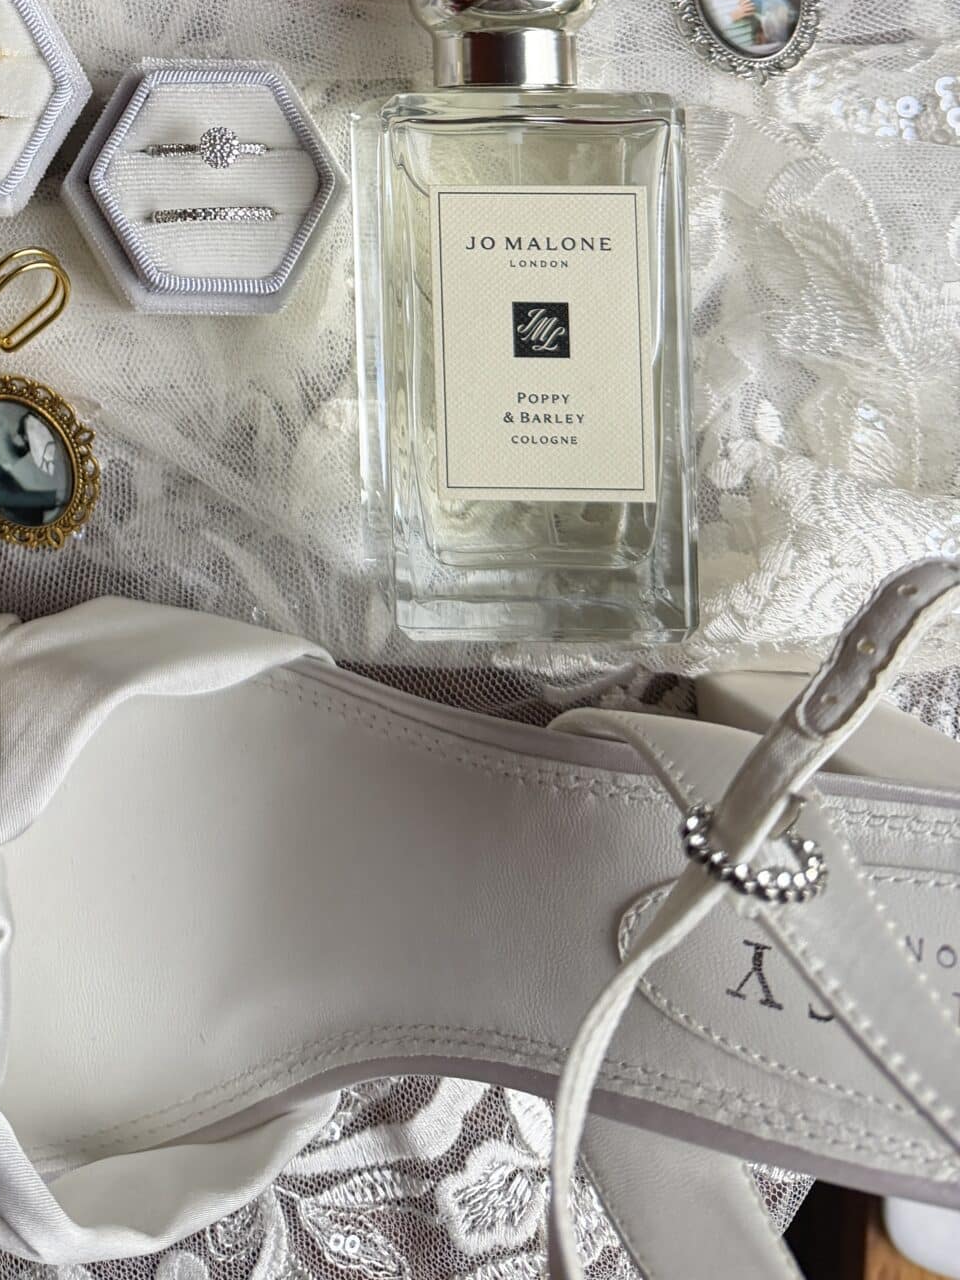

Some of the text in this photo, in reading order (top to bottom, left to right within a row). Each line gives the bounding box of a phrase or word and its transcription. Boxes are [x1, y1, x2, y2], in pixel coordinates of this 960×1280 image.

[465, 236, 612, 251] JO MALONE
[509, 259, 569, 268] LONDON
[517, 392, 570, 405] POPPY
[503, 411, 585, 424] & BARLEY
[511, 435, 578, 445] COLOGNE
